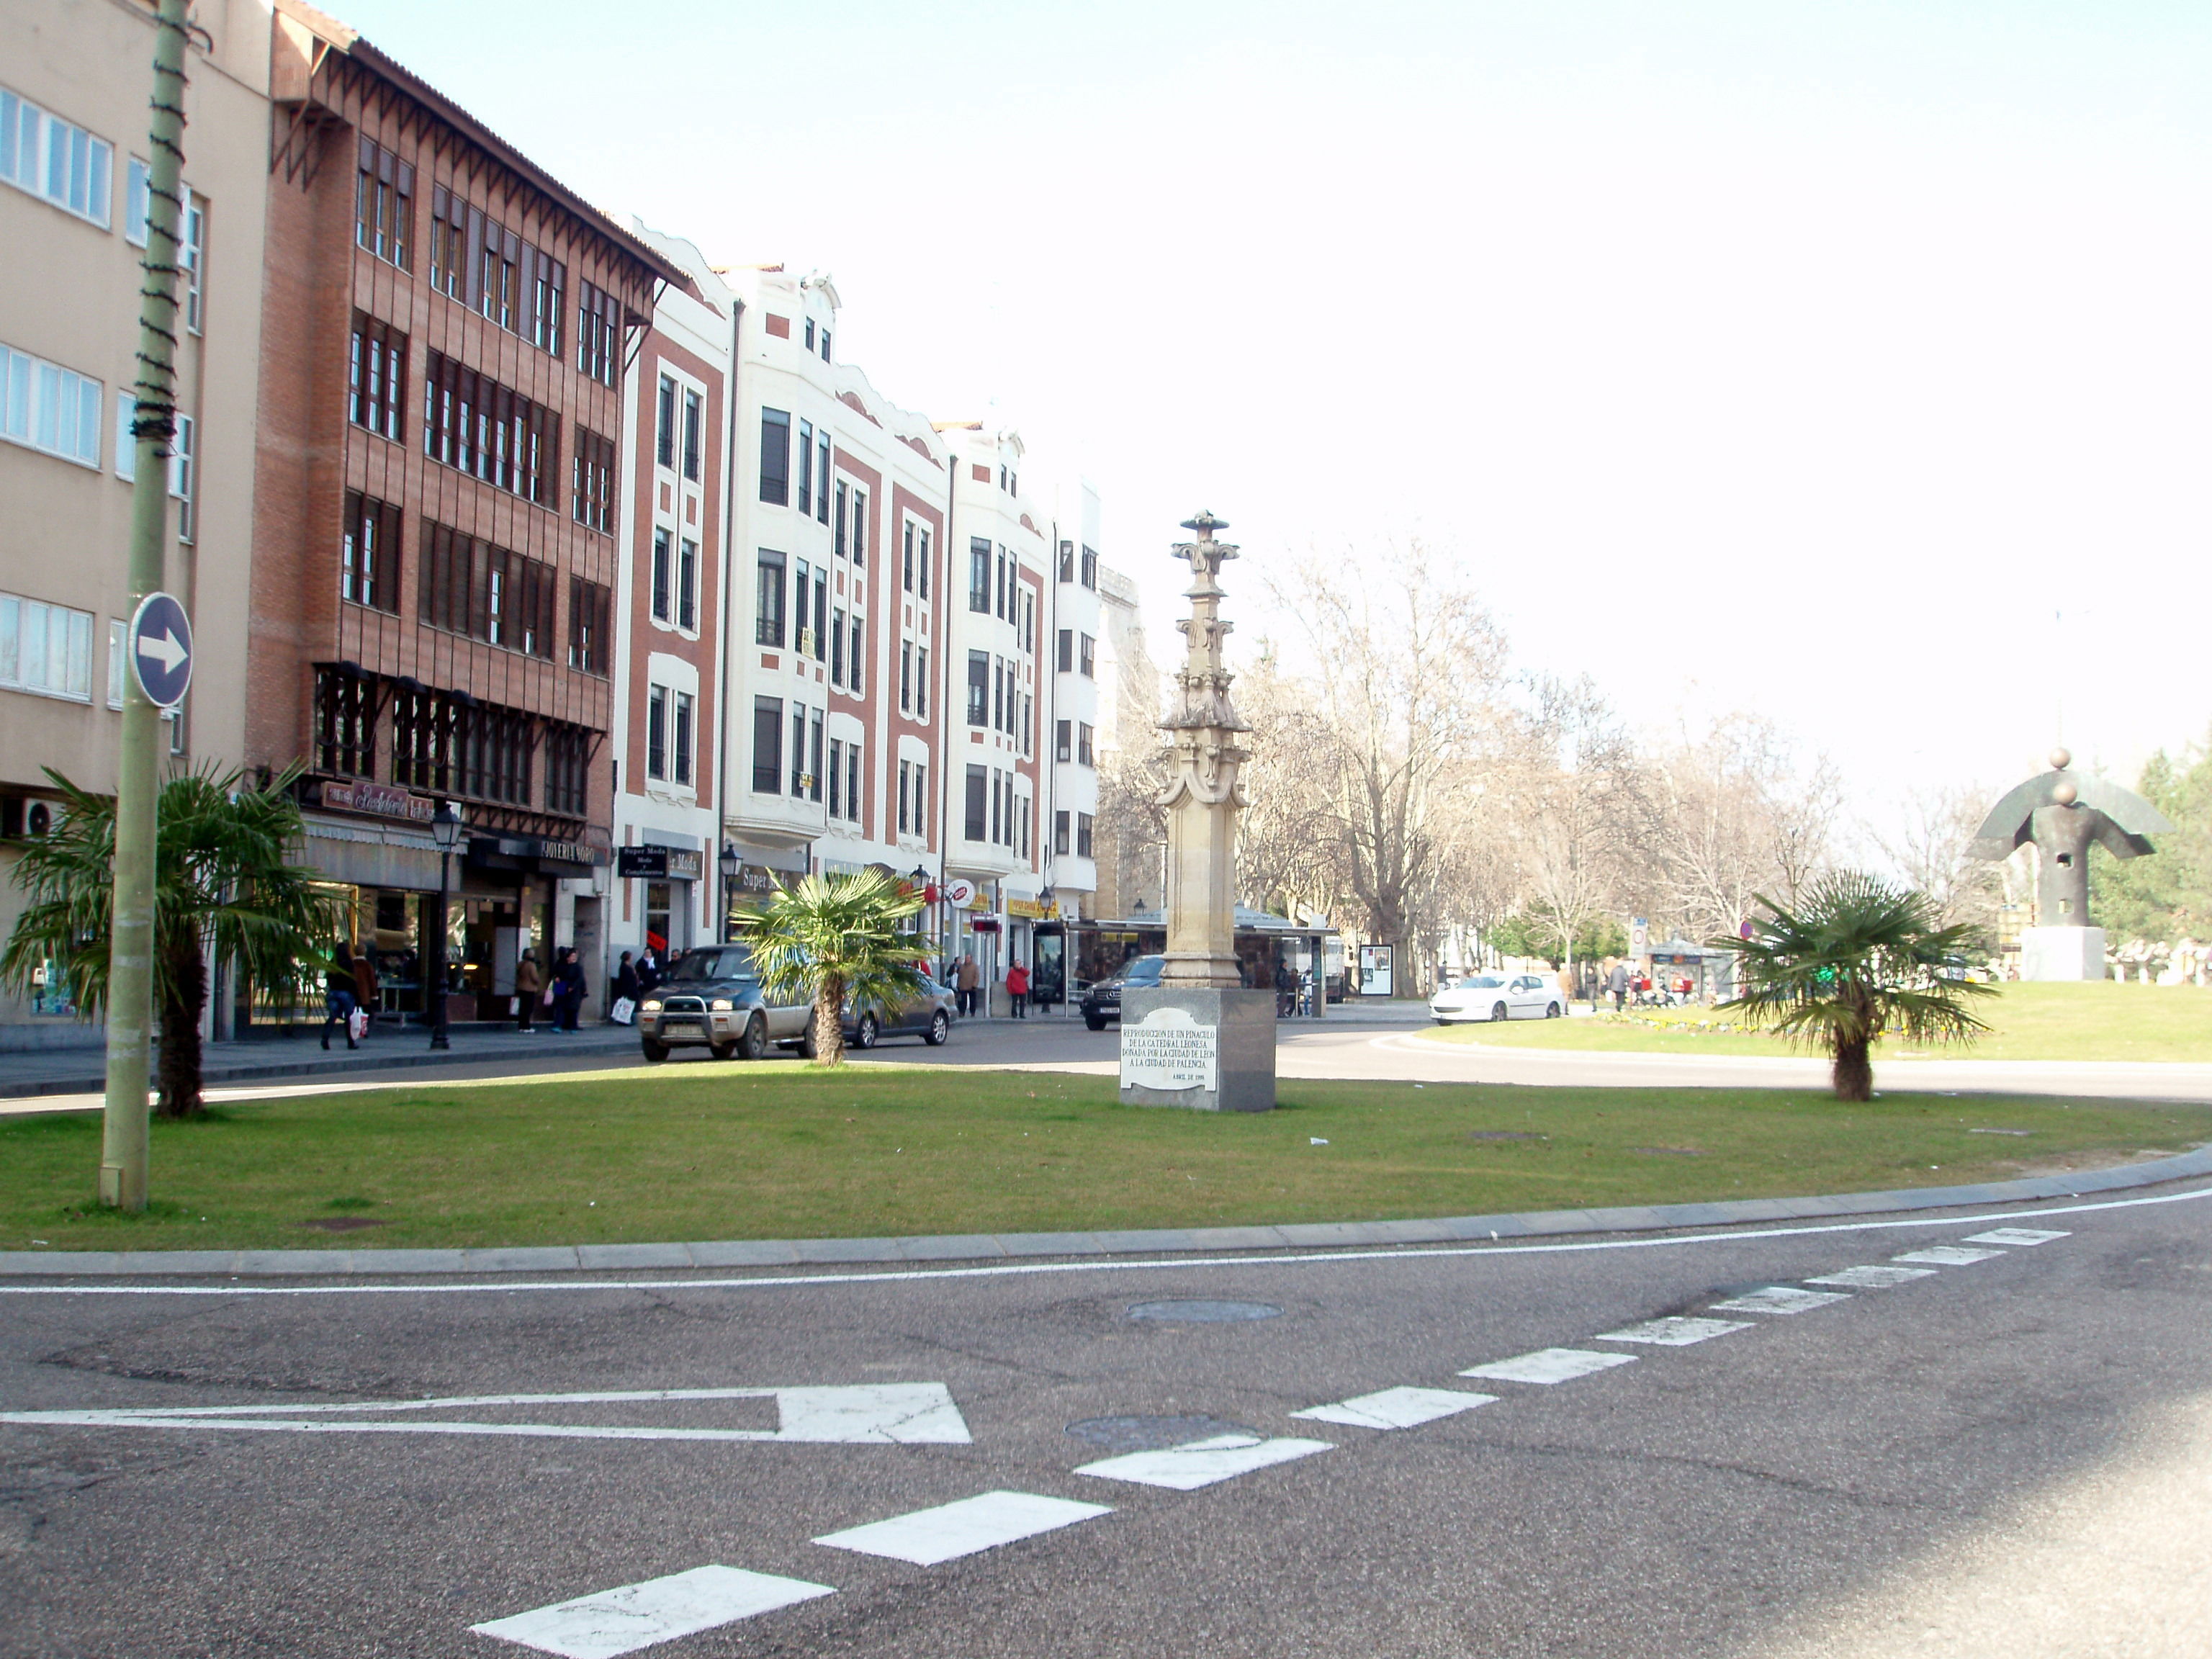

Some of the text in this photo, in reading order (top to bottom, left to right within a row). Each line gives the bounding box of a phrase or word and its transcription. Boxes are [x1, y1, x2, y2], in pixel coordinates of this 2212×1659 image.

[546, 841, 575, 861] JOYERIA
[624, 847, 644, 855] Super
[678, 853, 697, 871] Moda
[743, 868, 766, 891] Super
[1123, 1029, 1215, 1039] REPRODUCCION DE UN PINACULO
[1129, 1038, 1208, 1048] DE LA CATEDRAL LEONESA
[1169, 1049, 1190, 1058] CIUDAD
[1191, 1050, 1200, 1058] DE
[1200, 1050, 1215, 1058] LEON
[1136, 1058, 1143, 1067] LA
[1145, 1058, 1167, 1067] CIUDAD
[1177, 1059, 1206, 1069] PALENCIA
